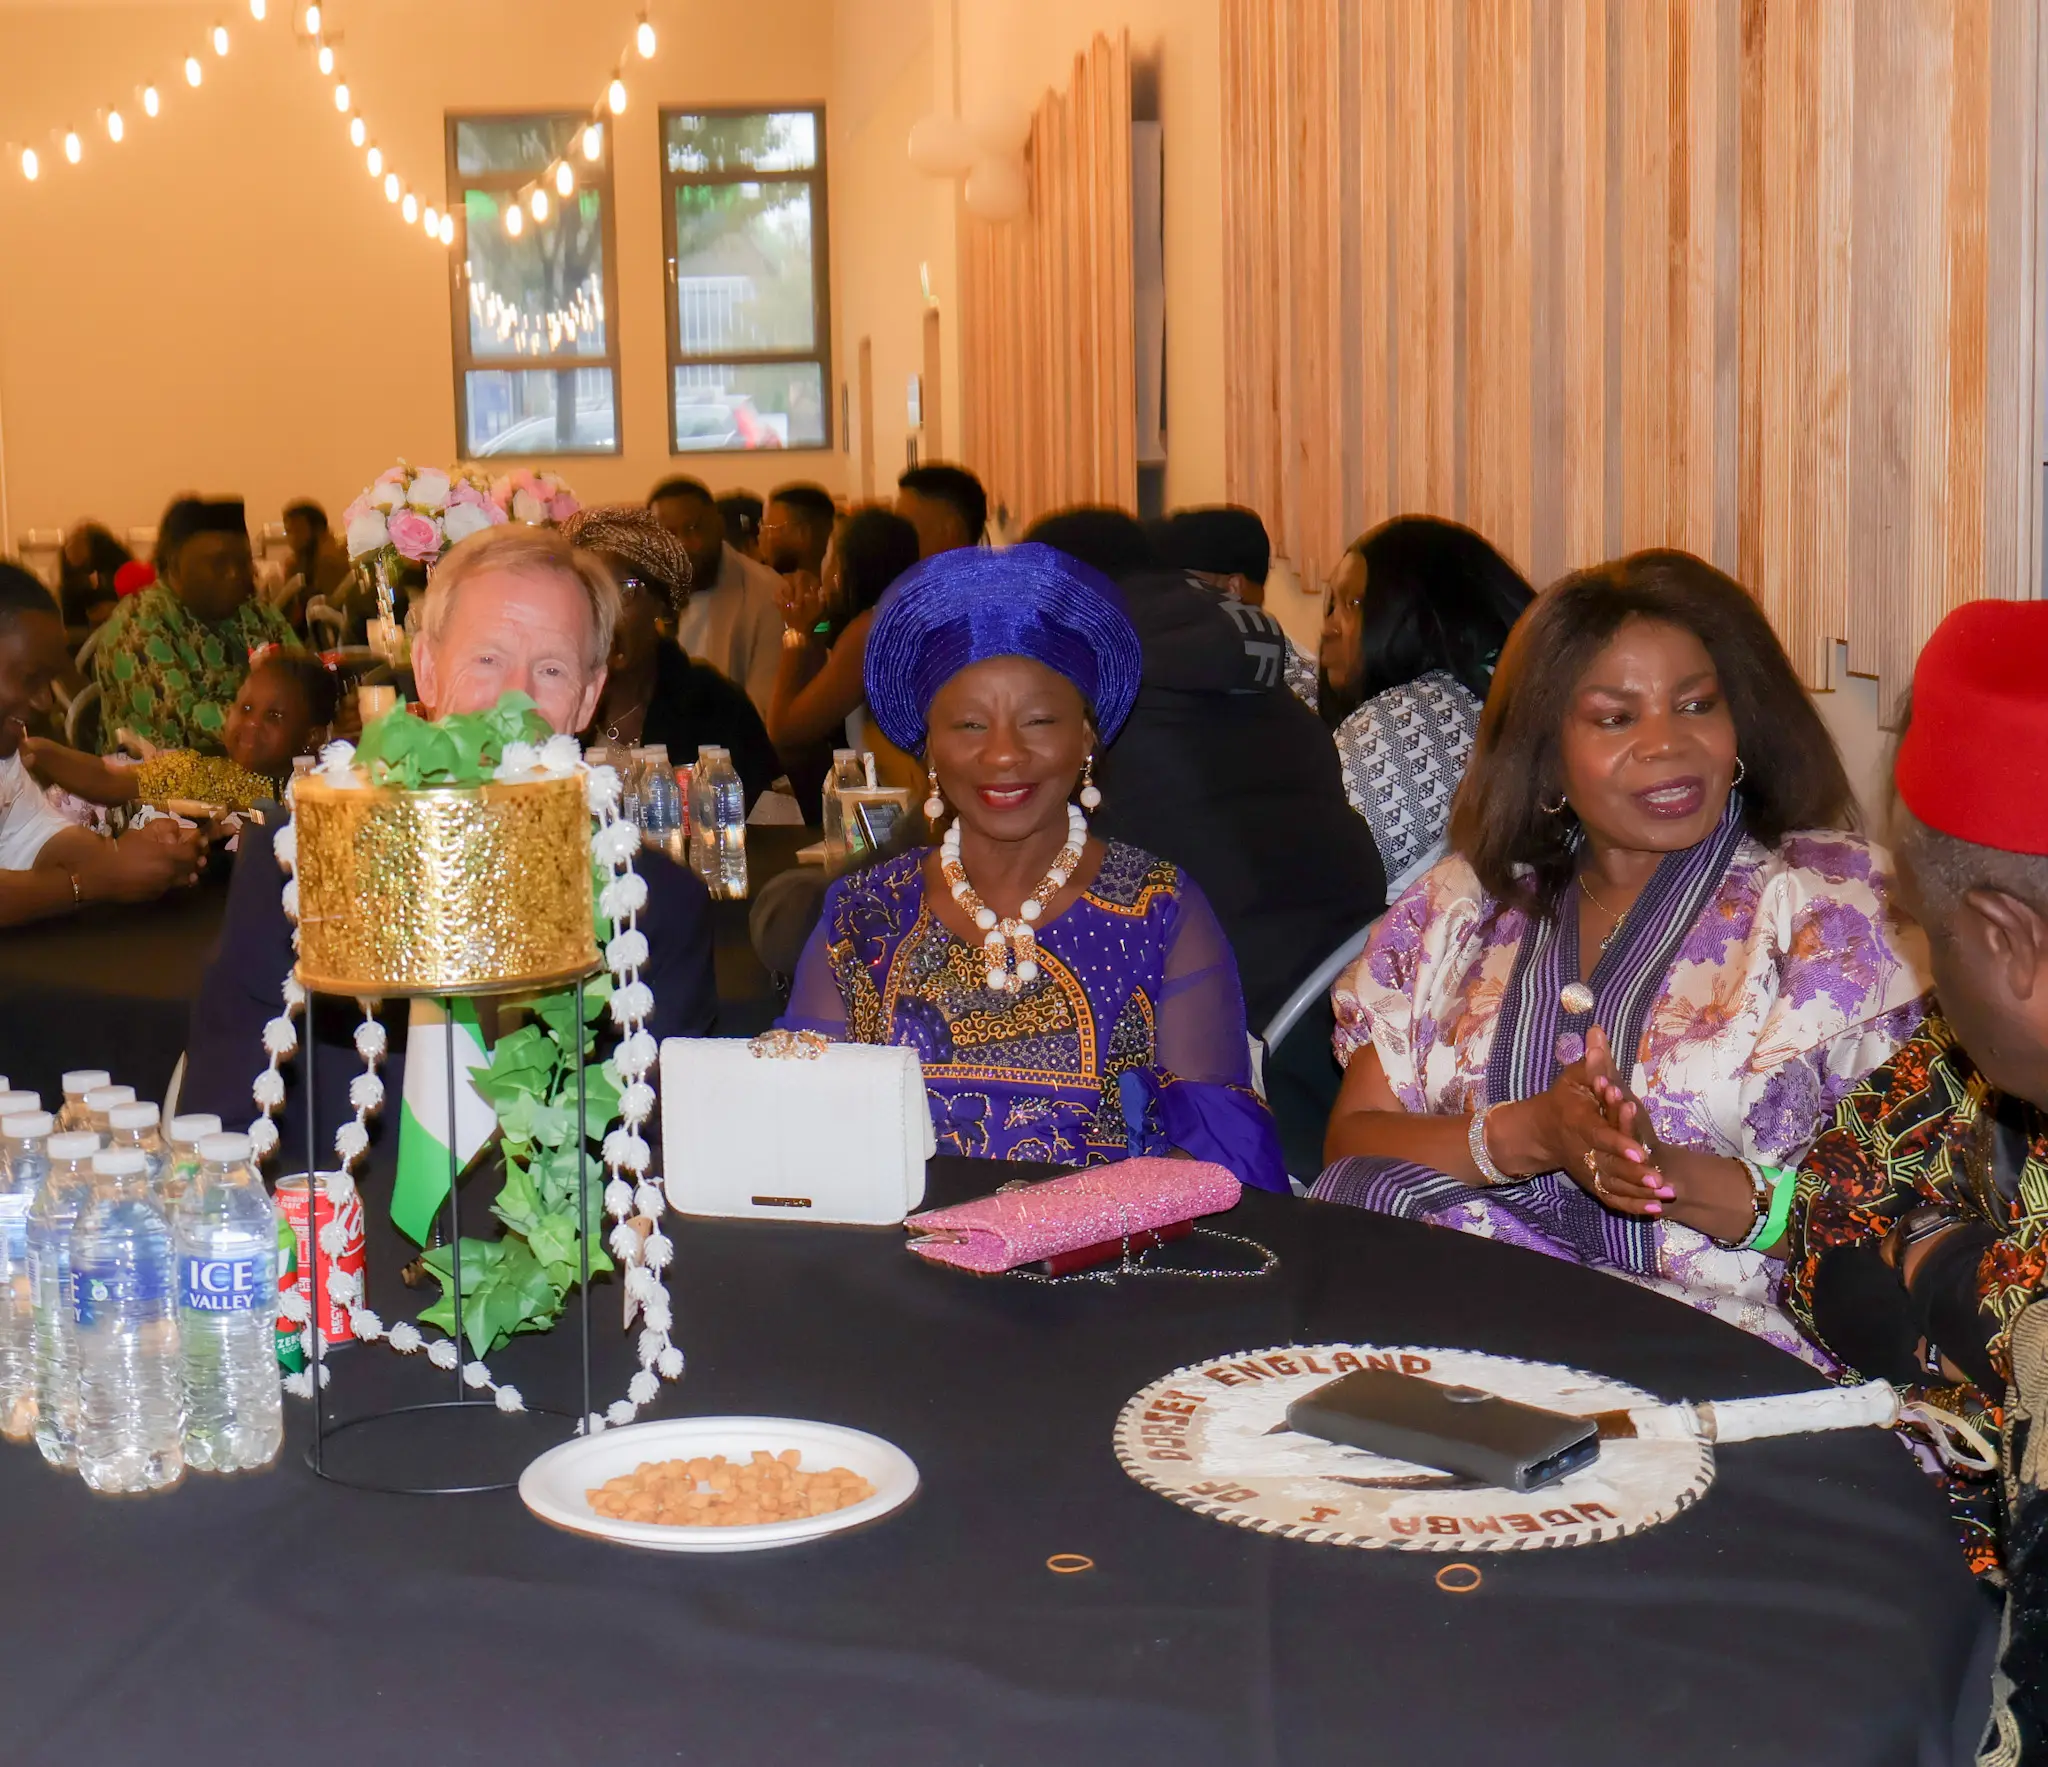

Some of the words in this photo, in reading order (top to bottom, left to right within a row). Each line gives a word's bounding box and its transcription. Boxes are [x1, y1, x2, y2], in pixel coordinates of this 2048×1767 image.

[190, 1260, 253, 1293] ICE
[189, 1293, 254, 1310] VALLEY
[1202, 1351, 1432, 1387] ENGLAND
[1141, 1389, 1208, 1461] DORSET
[1186, 1480, 1261, 1503] OF
